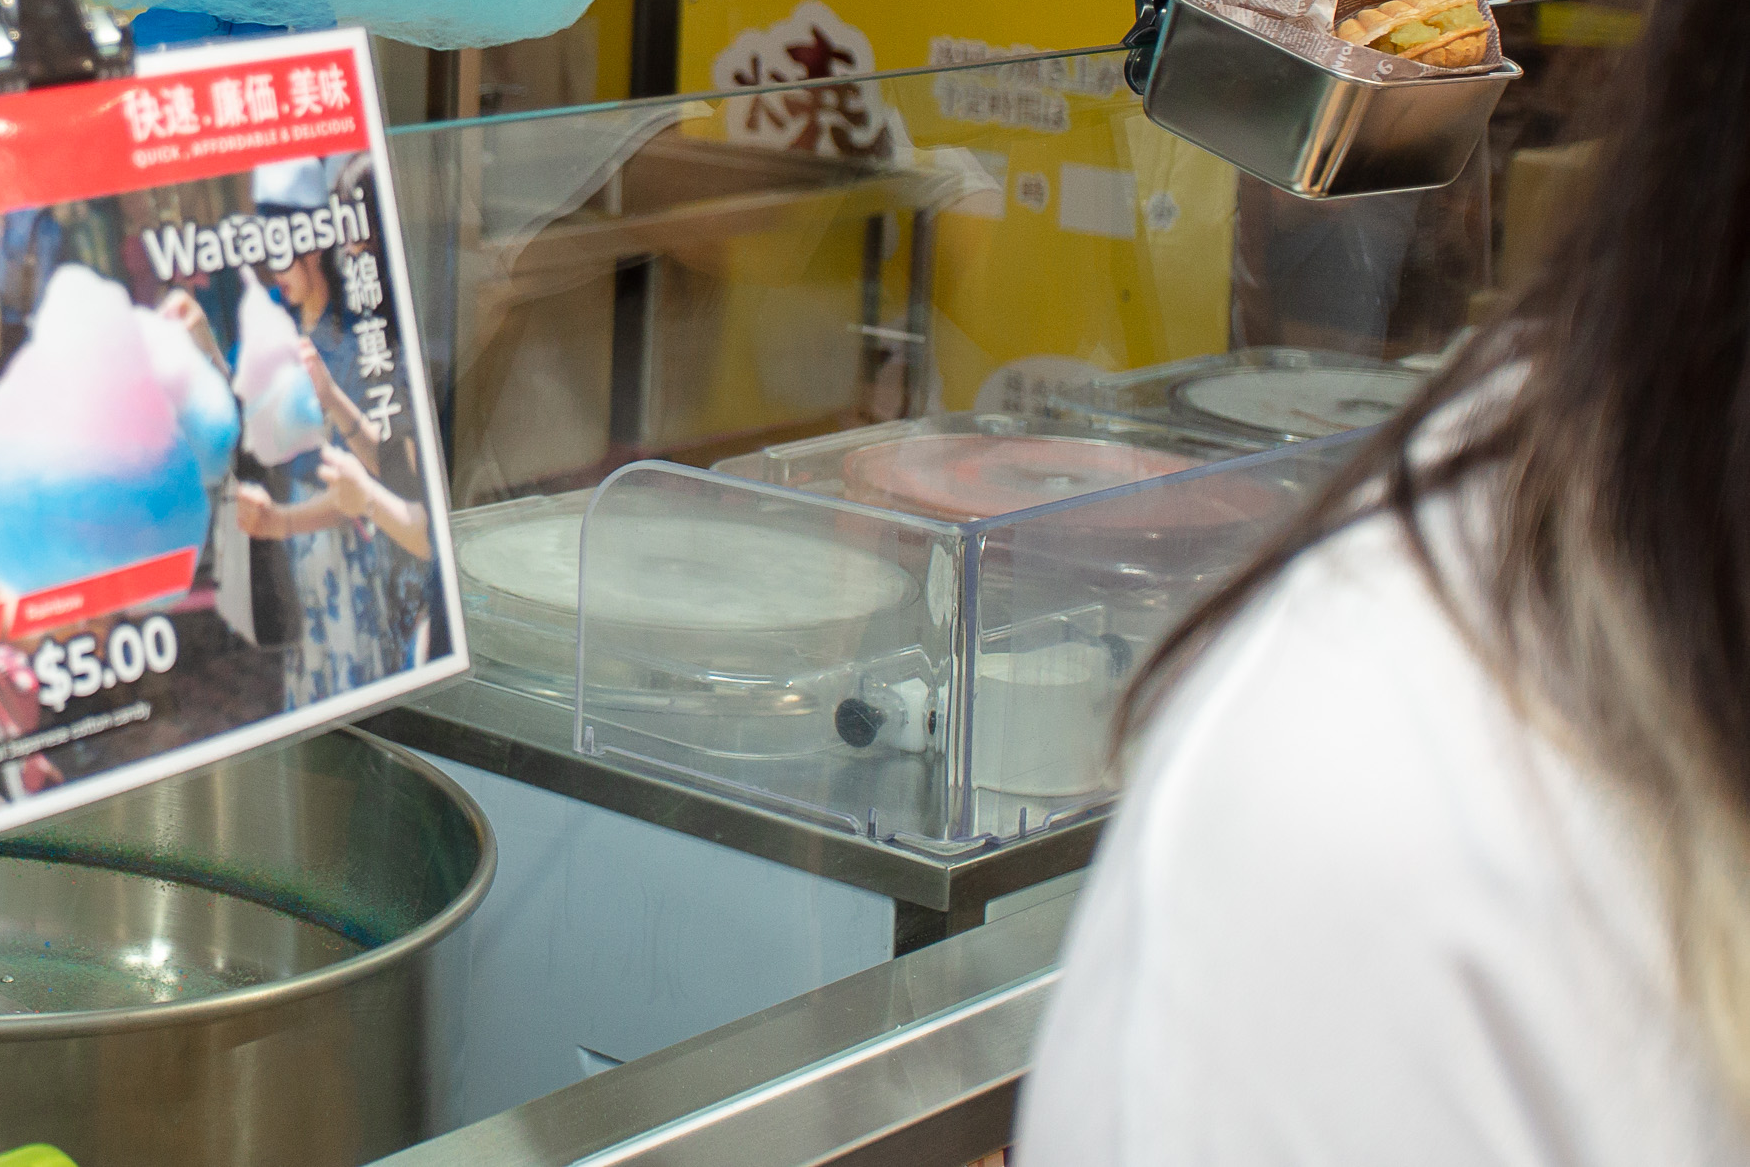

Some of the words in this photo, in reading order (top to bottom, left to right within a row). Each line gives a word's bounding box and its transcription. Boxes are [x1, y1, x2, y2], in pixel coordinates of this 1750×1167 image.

[192, 128, 277, 158] AFFORDABLE
[292, 117, 356, 142] DELICIOUS
[142, 187, 371, 281] Watagashi
[344, 252, 402, 442] 綿菓子
[34, 615, 178, 713] $5.00
